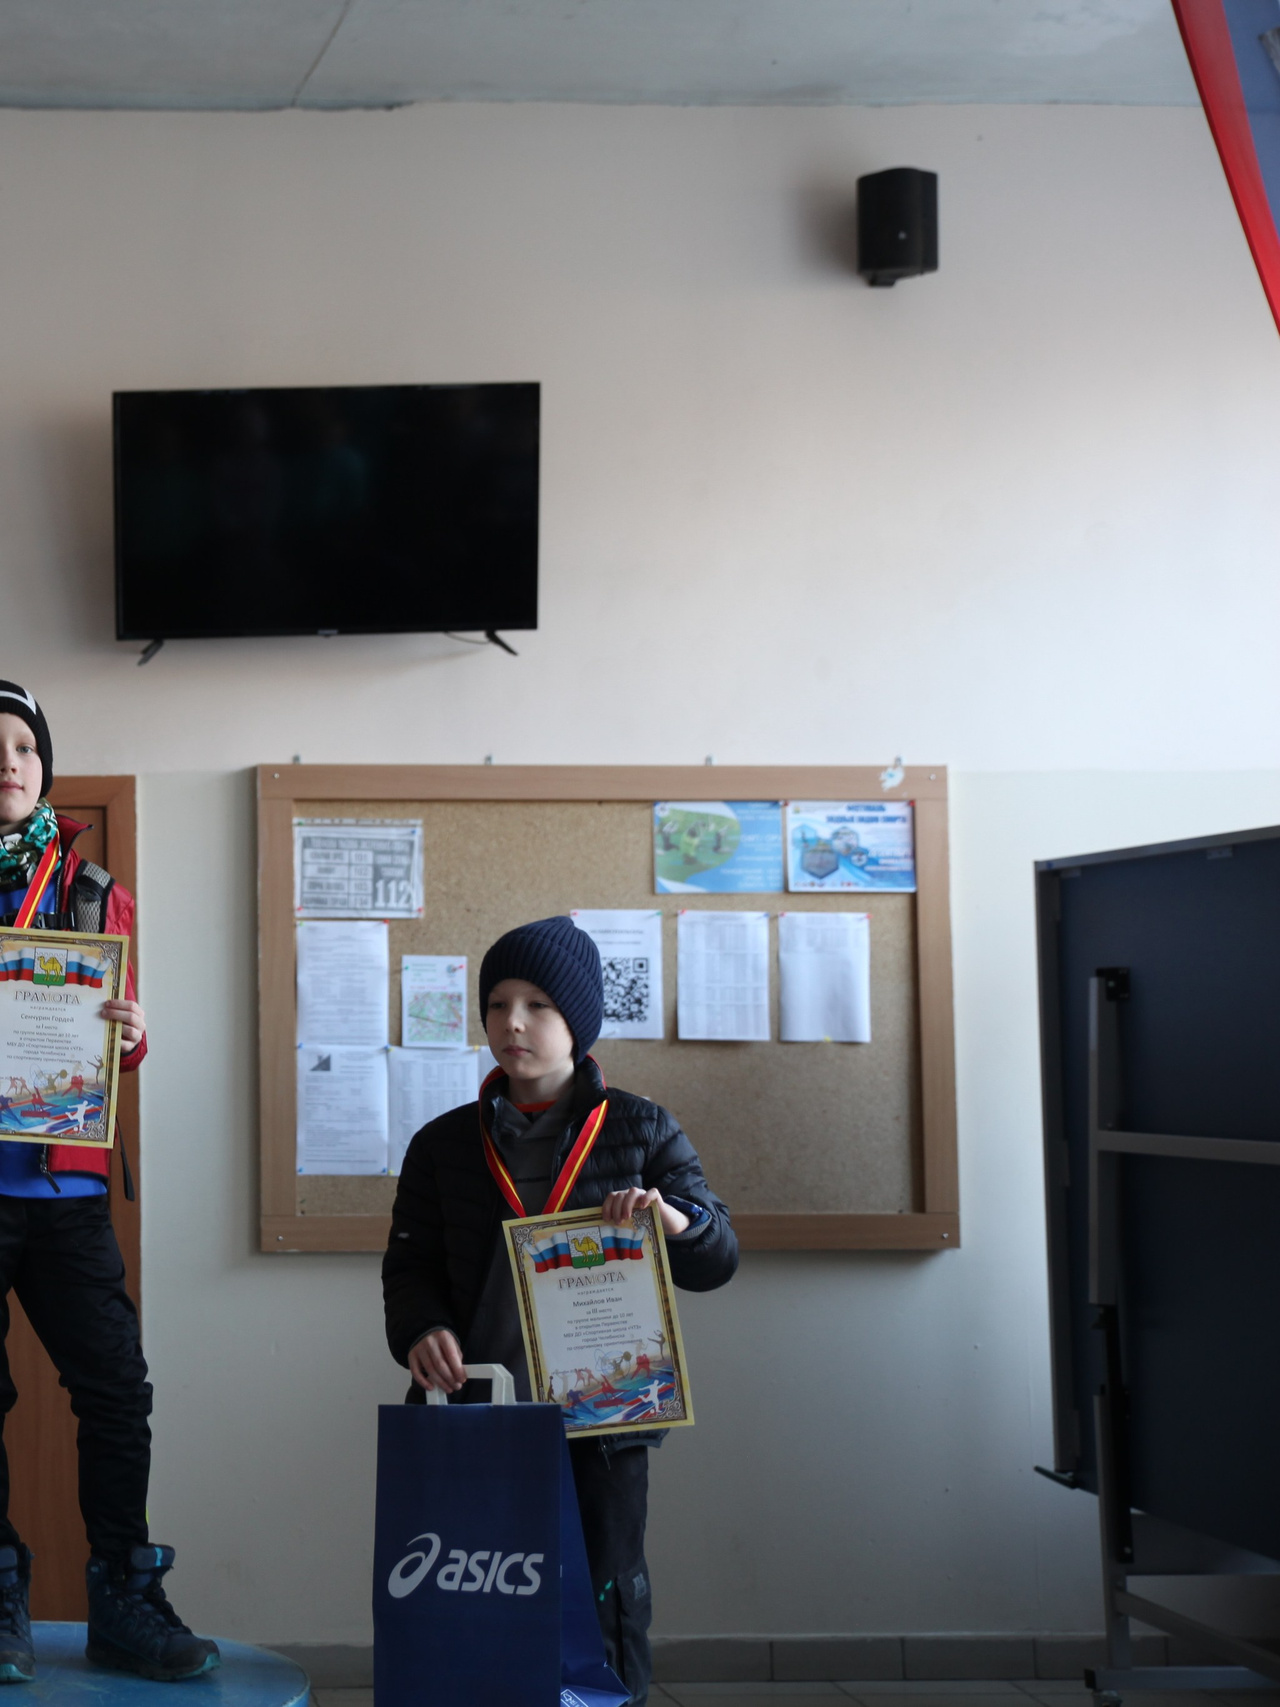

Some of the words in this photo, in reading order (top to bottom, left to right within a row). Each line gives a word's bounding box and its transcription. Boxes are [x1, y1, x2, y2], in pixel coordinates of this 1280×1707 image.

[375, 879, 412, 908] 112
[14, 990, 81, 1005] ГРАМОТА
[558, 1270, 627, 1289] ГРАМОТА
[573, 1298, 605, 1307] Михайлов
